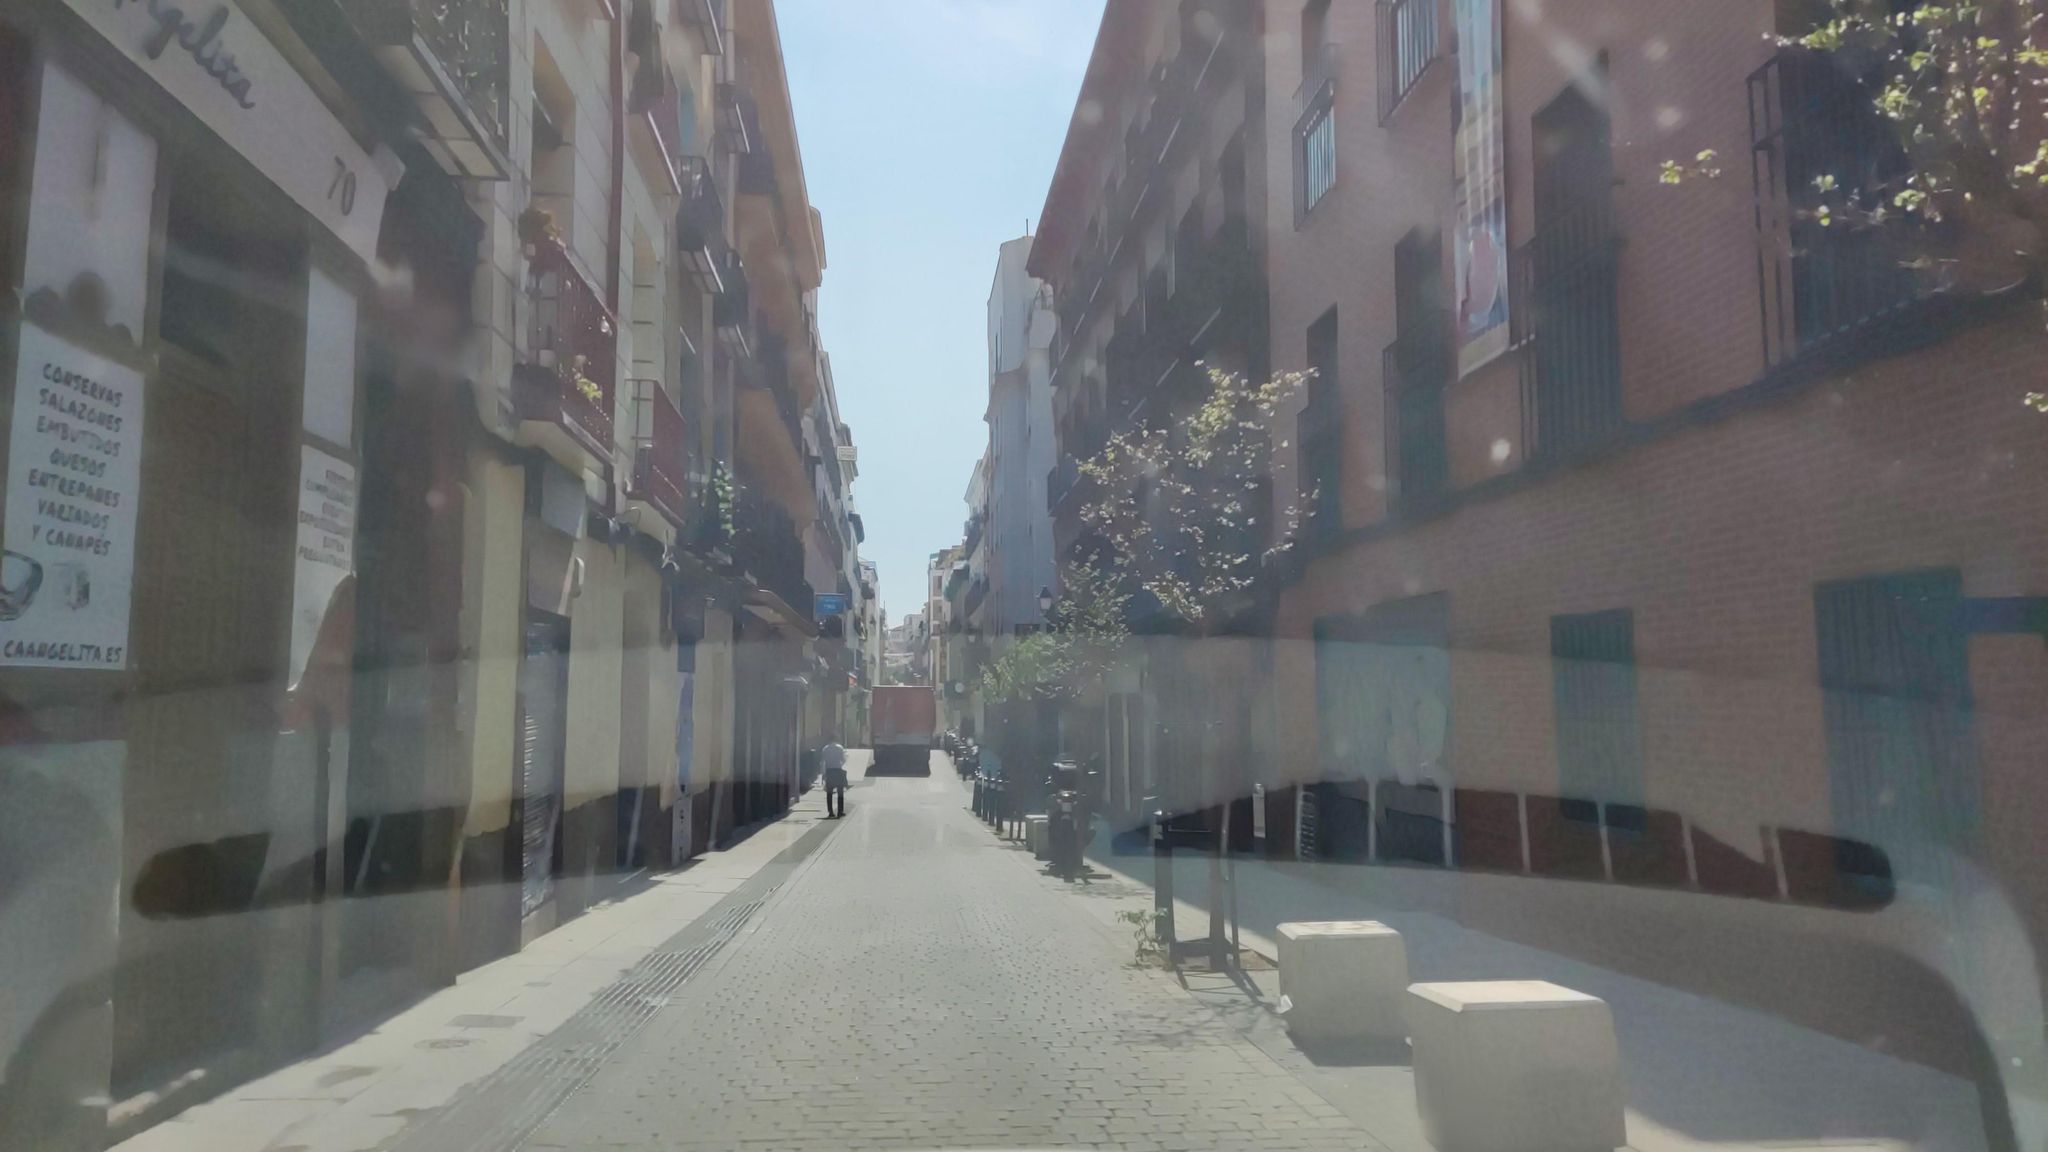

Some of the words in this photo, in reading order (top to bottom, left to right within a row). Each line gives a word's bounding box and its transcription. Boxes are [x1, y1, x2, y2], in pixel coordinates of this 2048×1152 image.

[328, 155, 357, 217] 70
[42, 363, 123, 408] CONSERVAS
[39, 388, 123, 433] SALAZONES
[49, 447, 107, 478] QUESOS
[28, 468, 121, 508] ENTREPANES
[32, 523, 42, 541] Y
[38, 498, 110, 530] VARIADOS
